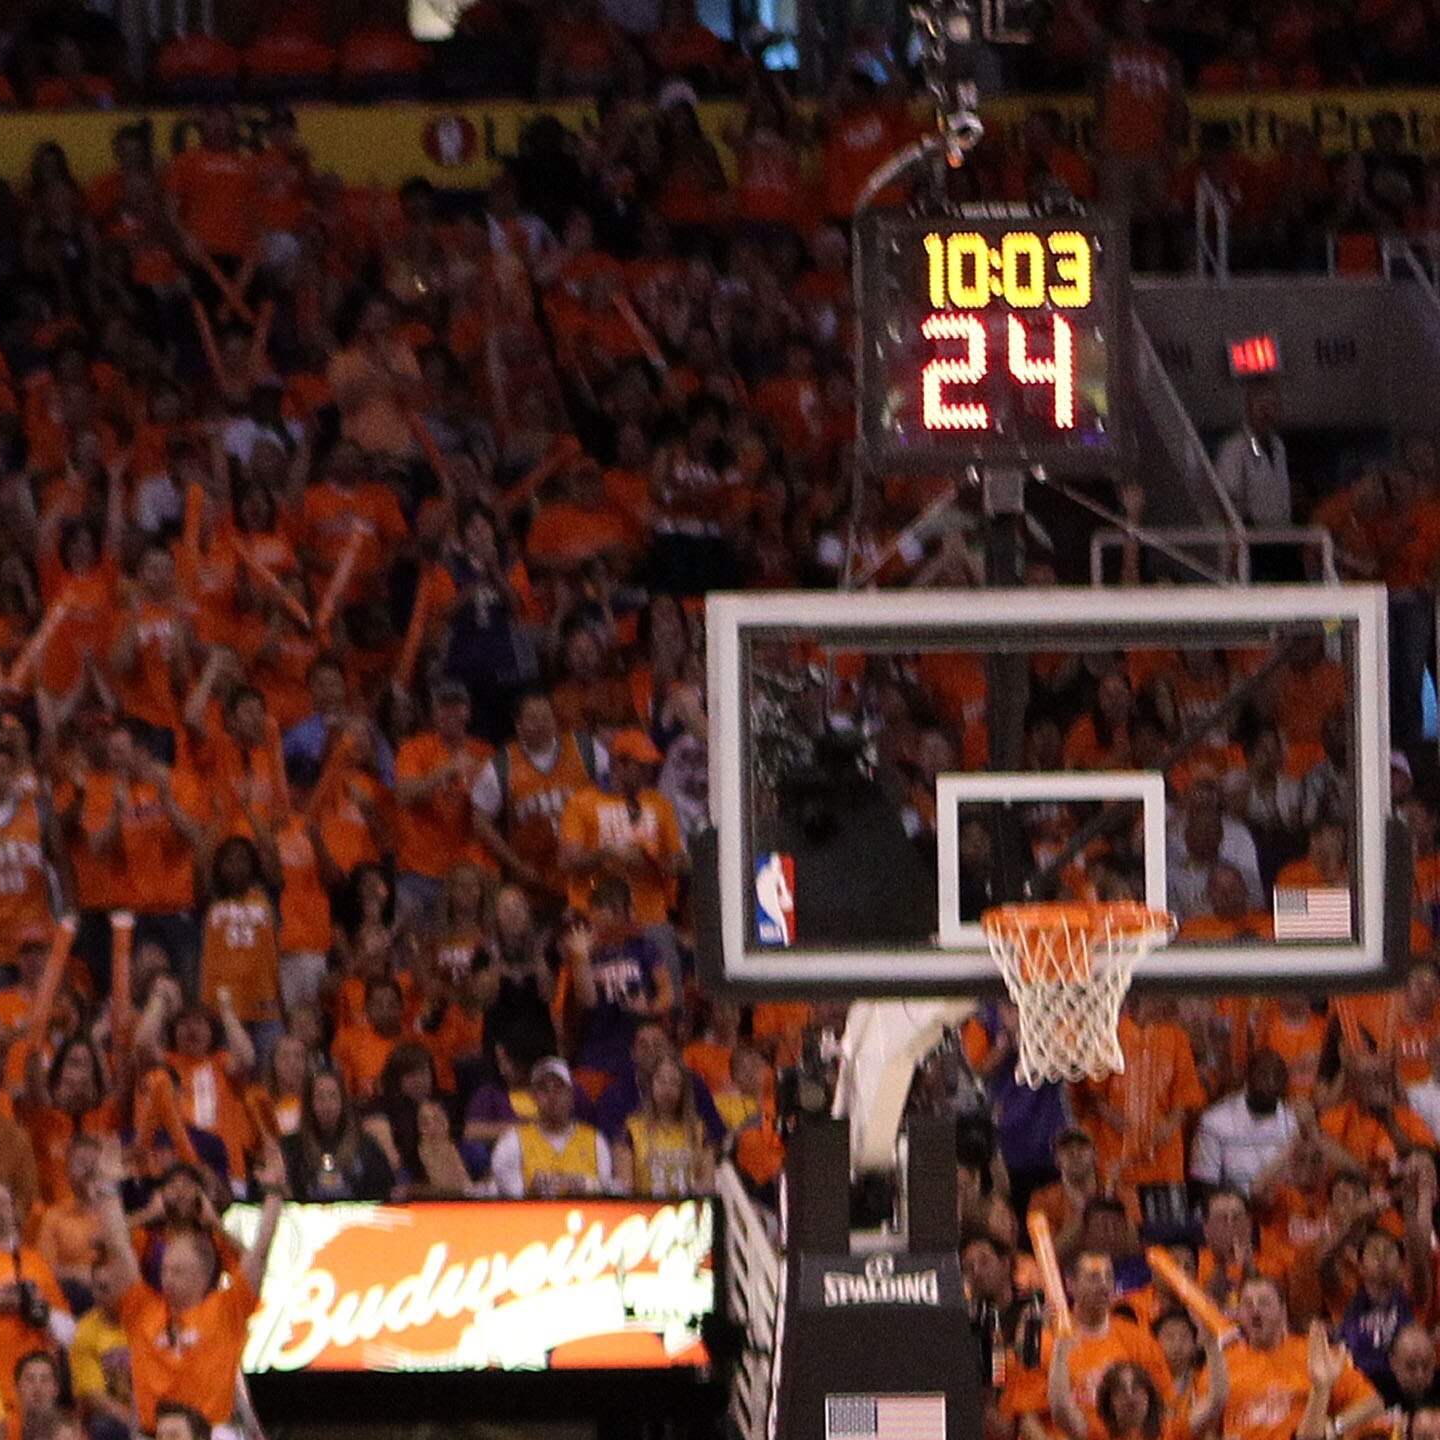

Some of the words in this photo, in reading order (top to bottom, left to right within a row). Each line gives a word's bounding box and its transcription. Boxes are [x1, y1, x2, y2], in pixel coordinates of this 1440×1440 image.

[923, 231, 1092, 308] 10:03
[921, 312, 1073, 430] 24
[823, 1268, 940, 1307] SPALDING
